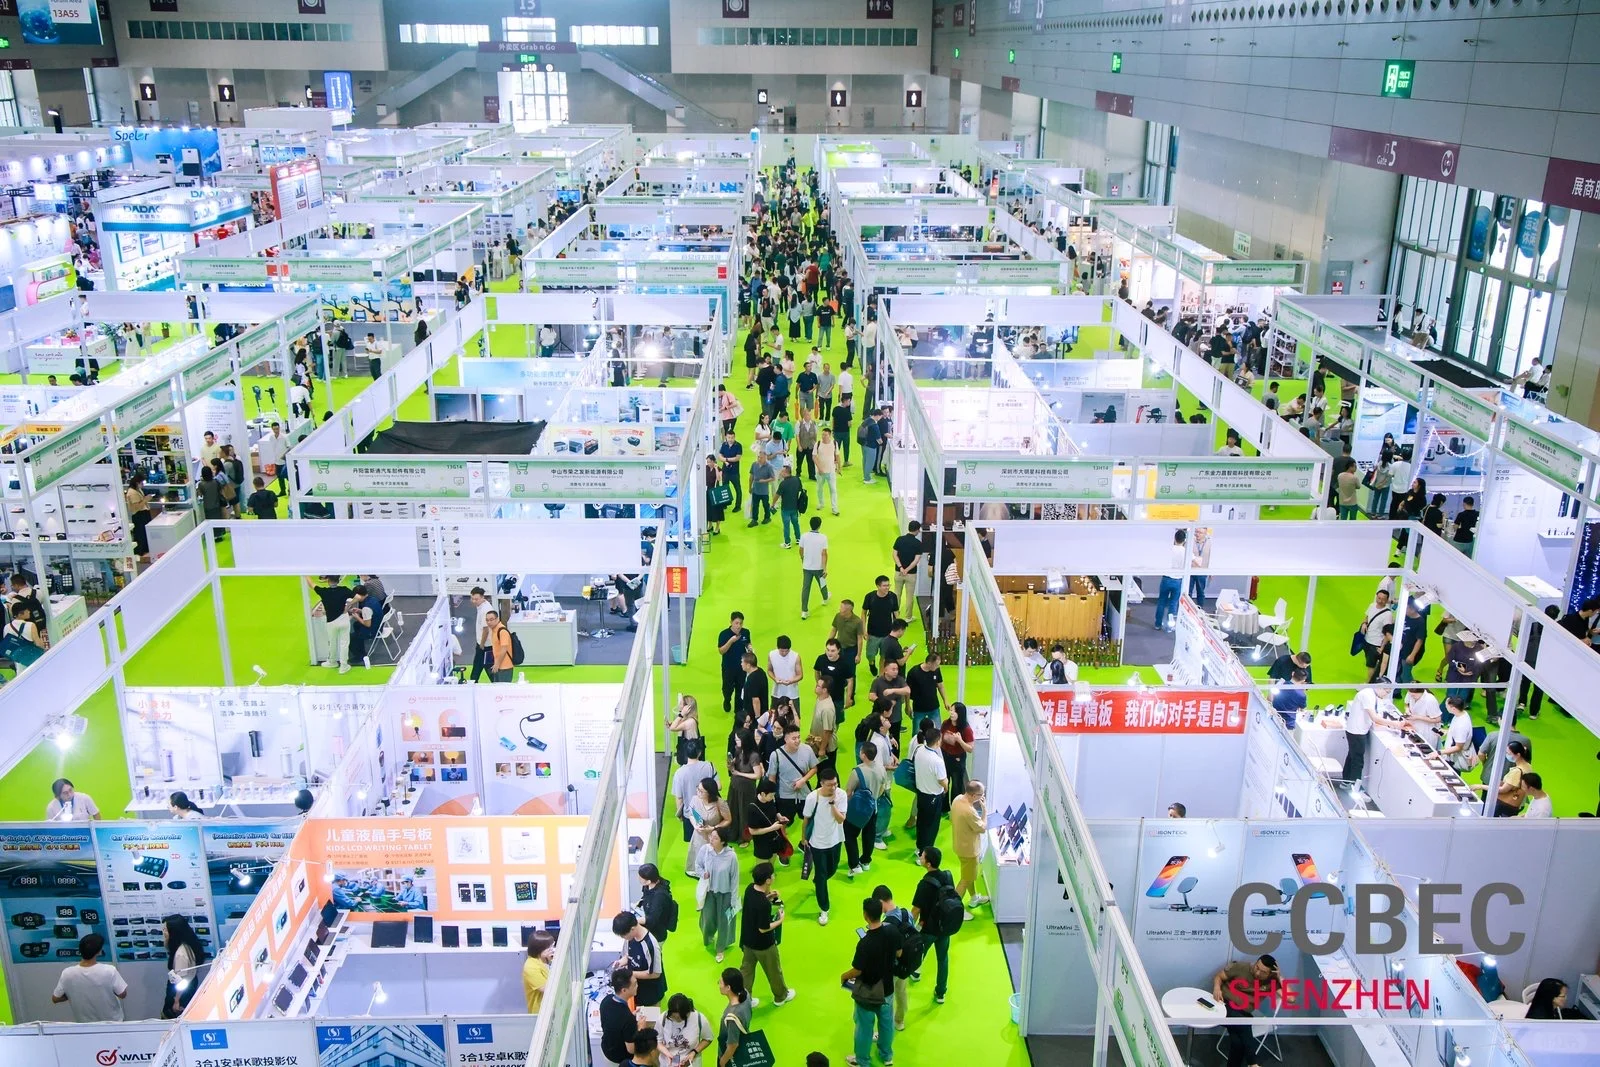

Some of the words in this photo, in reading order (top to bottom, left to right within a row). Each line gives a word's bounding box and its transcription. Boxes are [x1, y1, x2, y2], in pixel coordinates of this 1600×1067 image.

[499, 43, 520, 51] 外卖区
[1376, 154, 1388, 166] Gate
[1388, 141, 1398, 167] 5
[1501, 198, 1516, 219] 15
[1124, 700, 1240, 729] 我们的对手是自己
[327, 829, 433, 842] 儿童液晶手写板
[195, 1056, 298, 1067] 3合1安卓K歌投影仪
